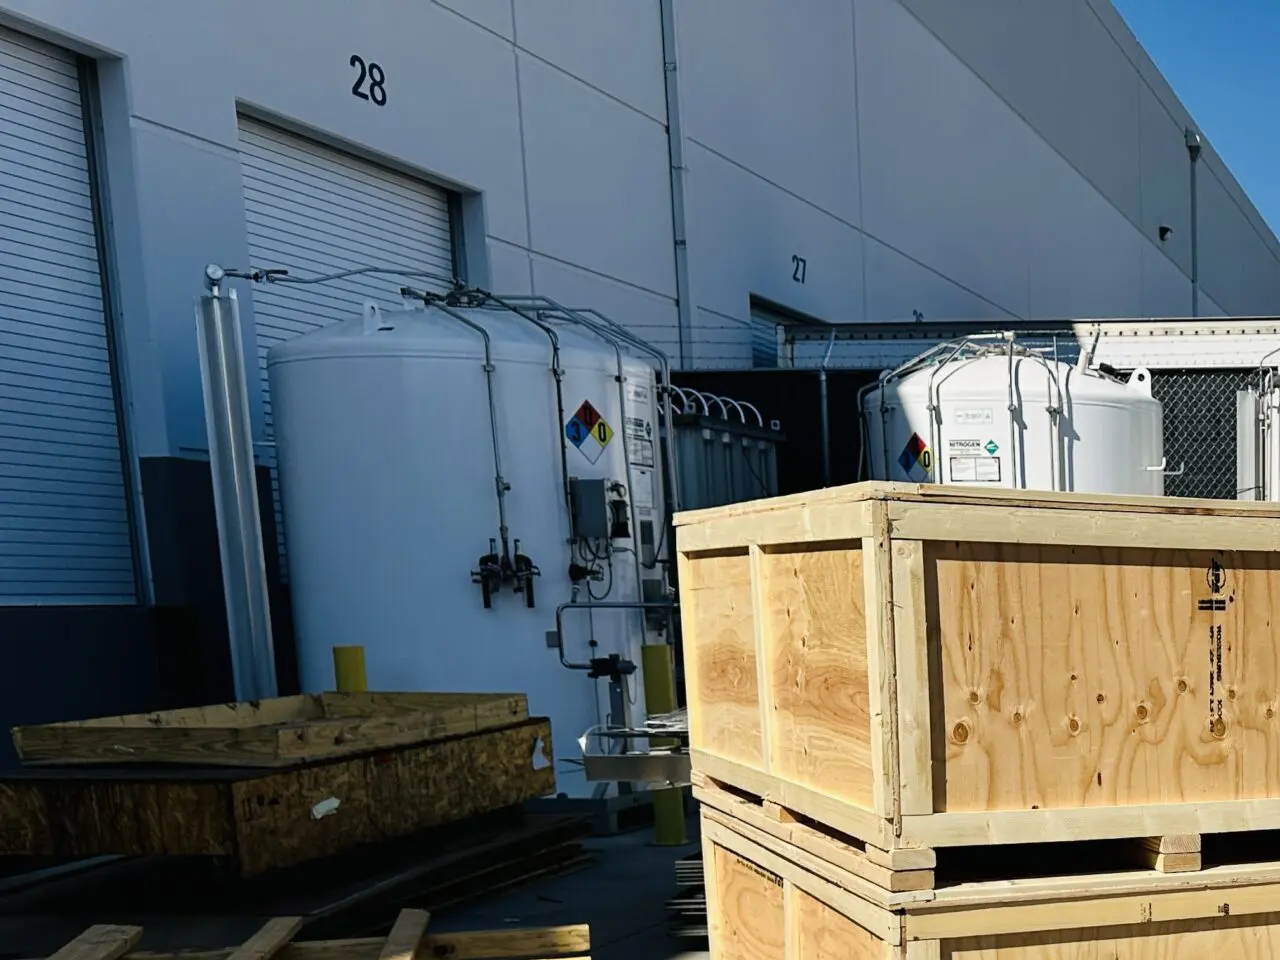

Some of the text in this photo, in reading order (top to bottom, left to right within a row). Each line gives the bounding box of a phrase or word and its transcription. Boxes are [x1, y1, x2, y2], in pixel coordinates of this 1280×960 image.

[350, 54, 387, 107] 28
[792, 254, 806, 284] 27
[571, 421, 580, 442] 3
[598, 422, 607, 442] 0
[923, 450, 930, 468] 0
